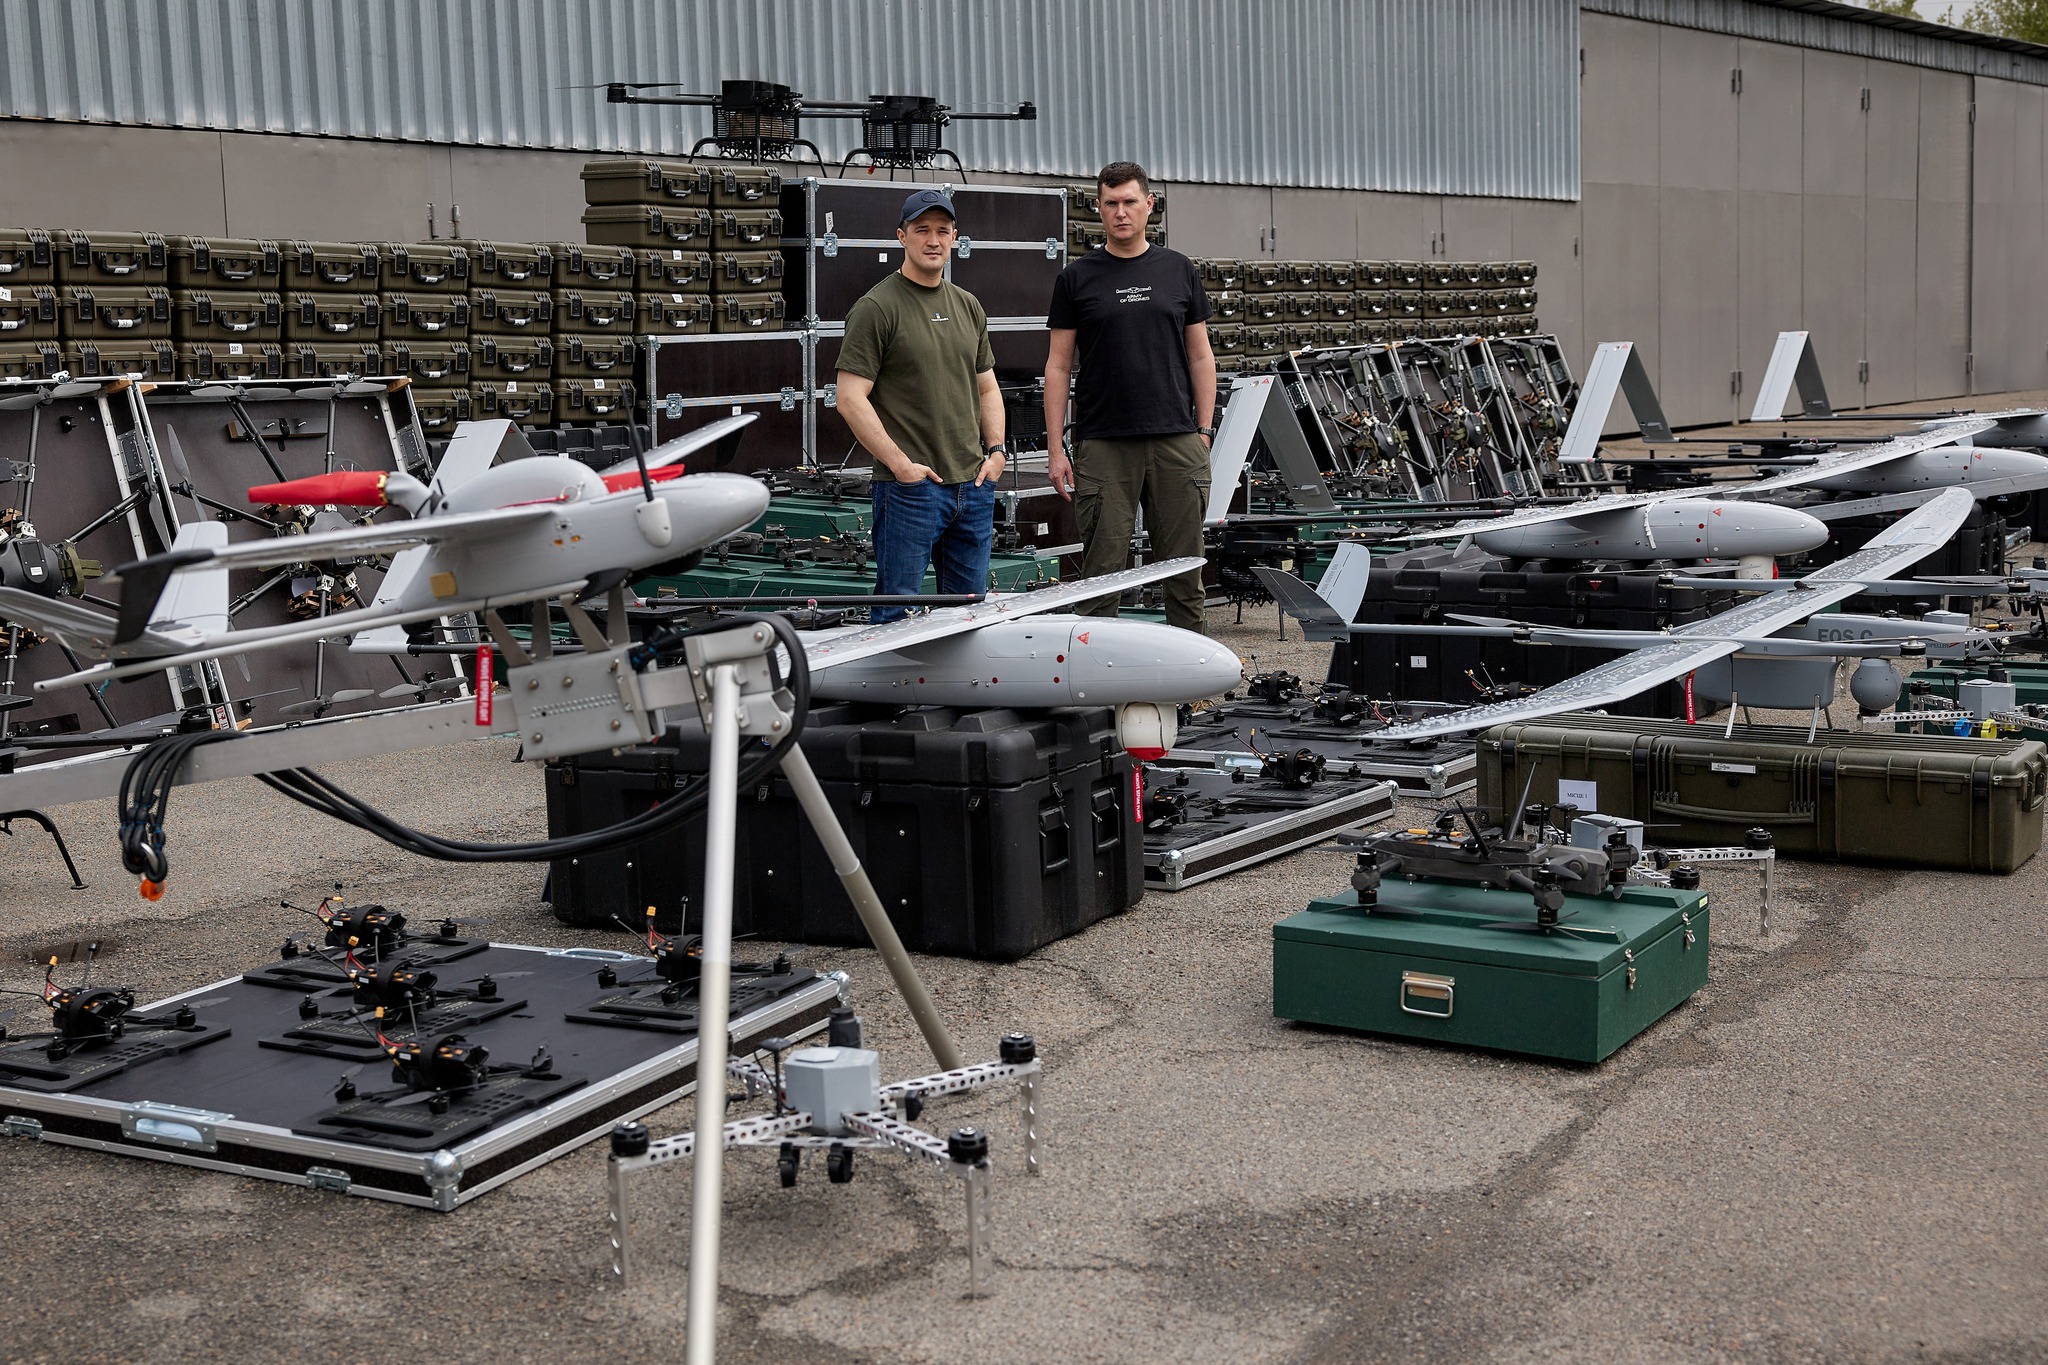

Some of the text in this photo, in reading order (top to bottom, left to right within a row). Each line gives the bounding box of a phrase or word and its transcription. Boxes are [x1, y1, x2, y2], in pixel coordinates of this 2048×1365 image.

[1818, 629, 1853, 642] EOS
[479, 657, 490, 722] REMOVE BEFORE FLIGHT
